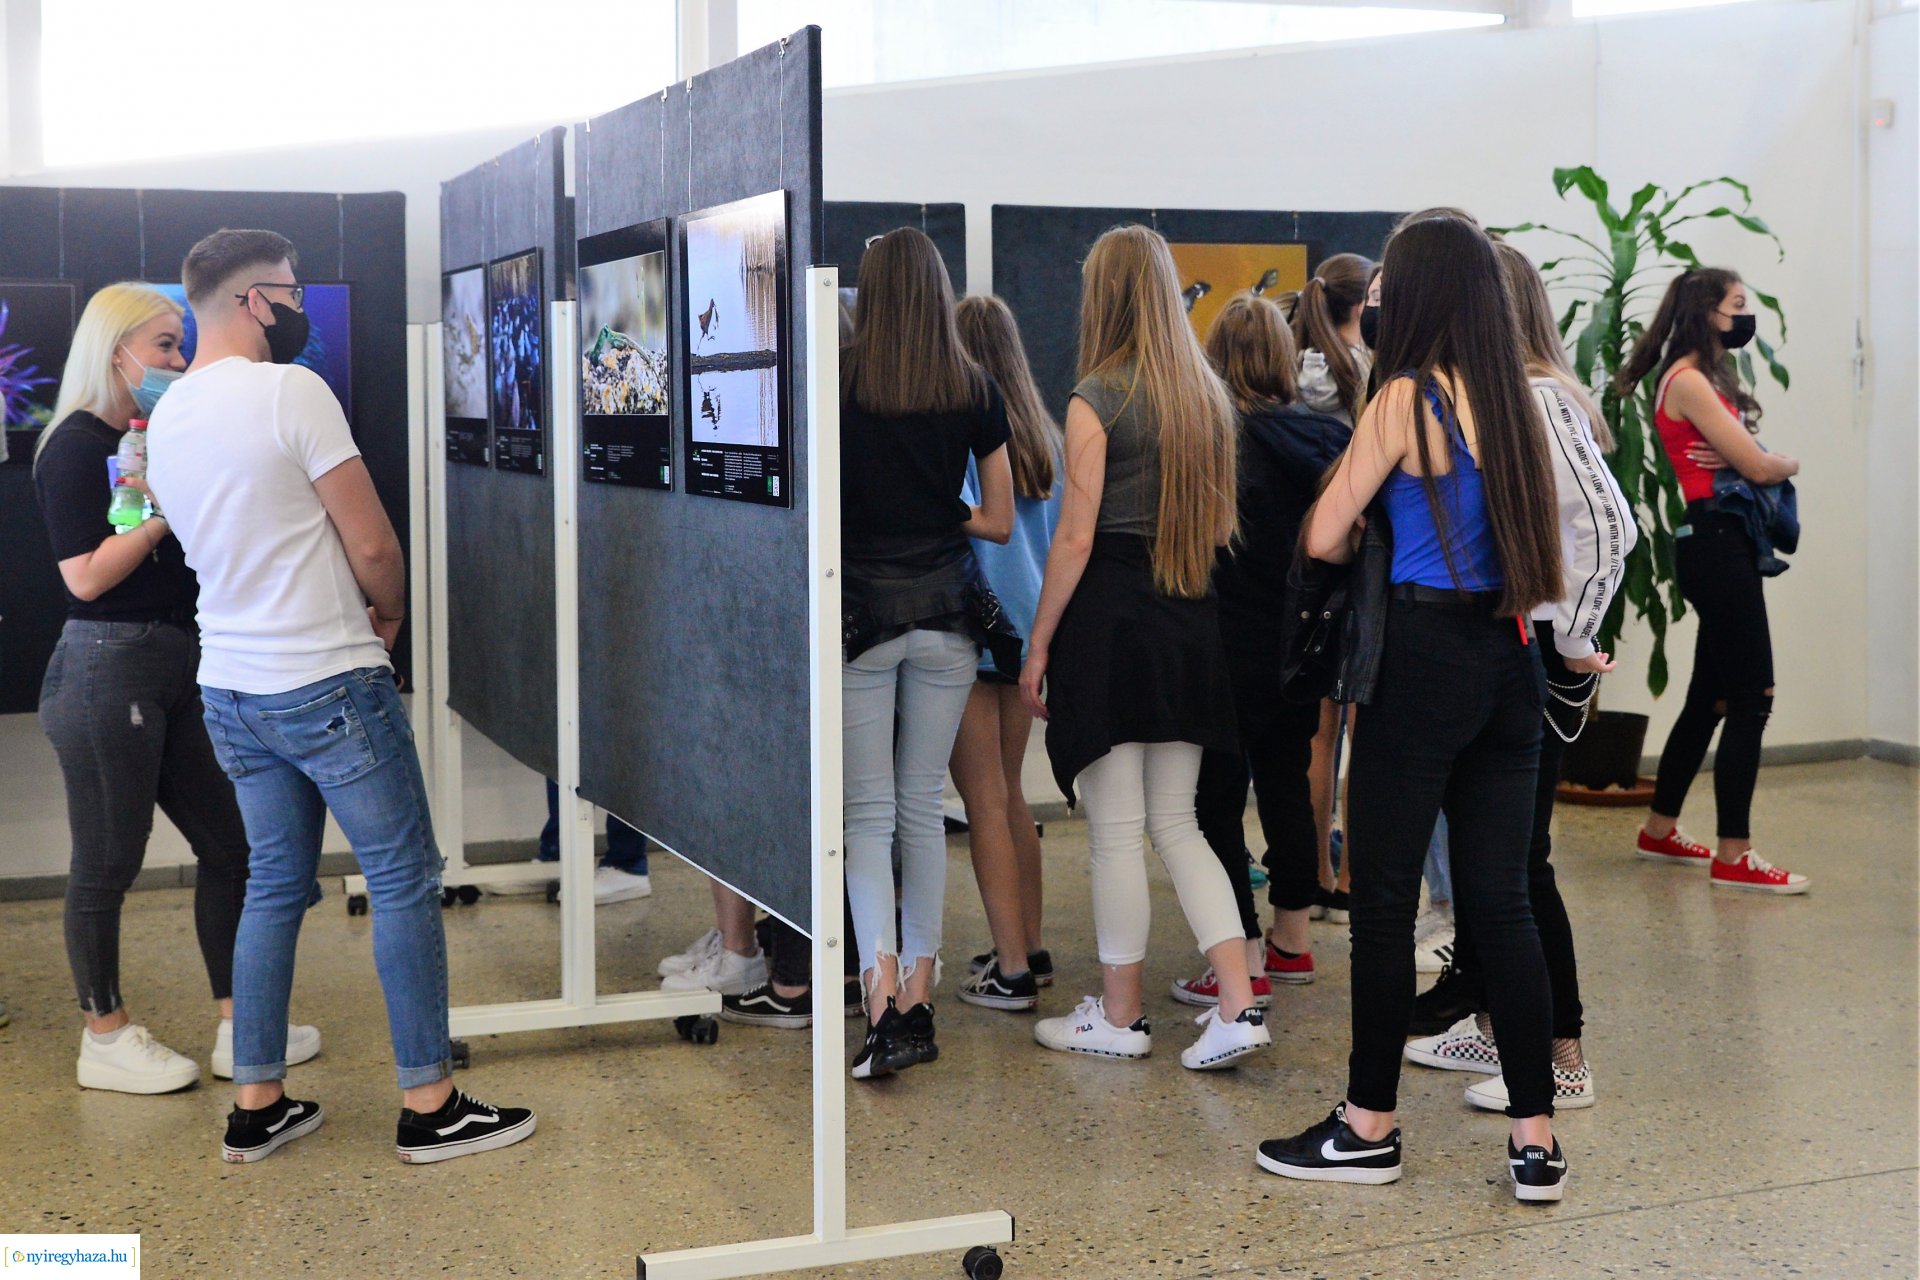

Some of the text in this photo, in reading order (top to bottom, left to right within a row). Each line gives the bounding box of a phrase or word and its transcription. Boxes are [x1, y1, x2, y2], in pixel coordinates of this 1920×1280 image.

[1560, 407, 1572, 424] WITH
[1592, 478, 1605, 495] LOVE
[1609, 523, 1619, 541] WITH
[1610, 541, 1620, 557] LOVE
[1597, 581, 1606, 597] WITH
[1592, 595, 1604, 611] LOVE
[1075, 1023, 1093, 1034] FILA
[1526, 1151, 1545, 1160] NIKE
